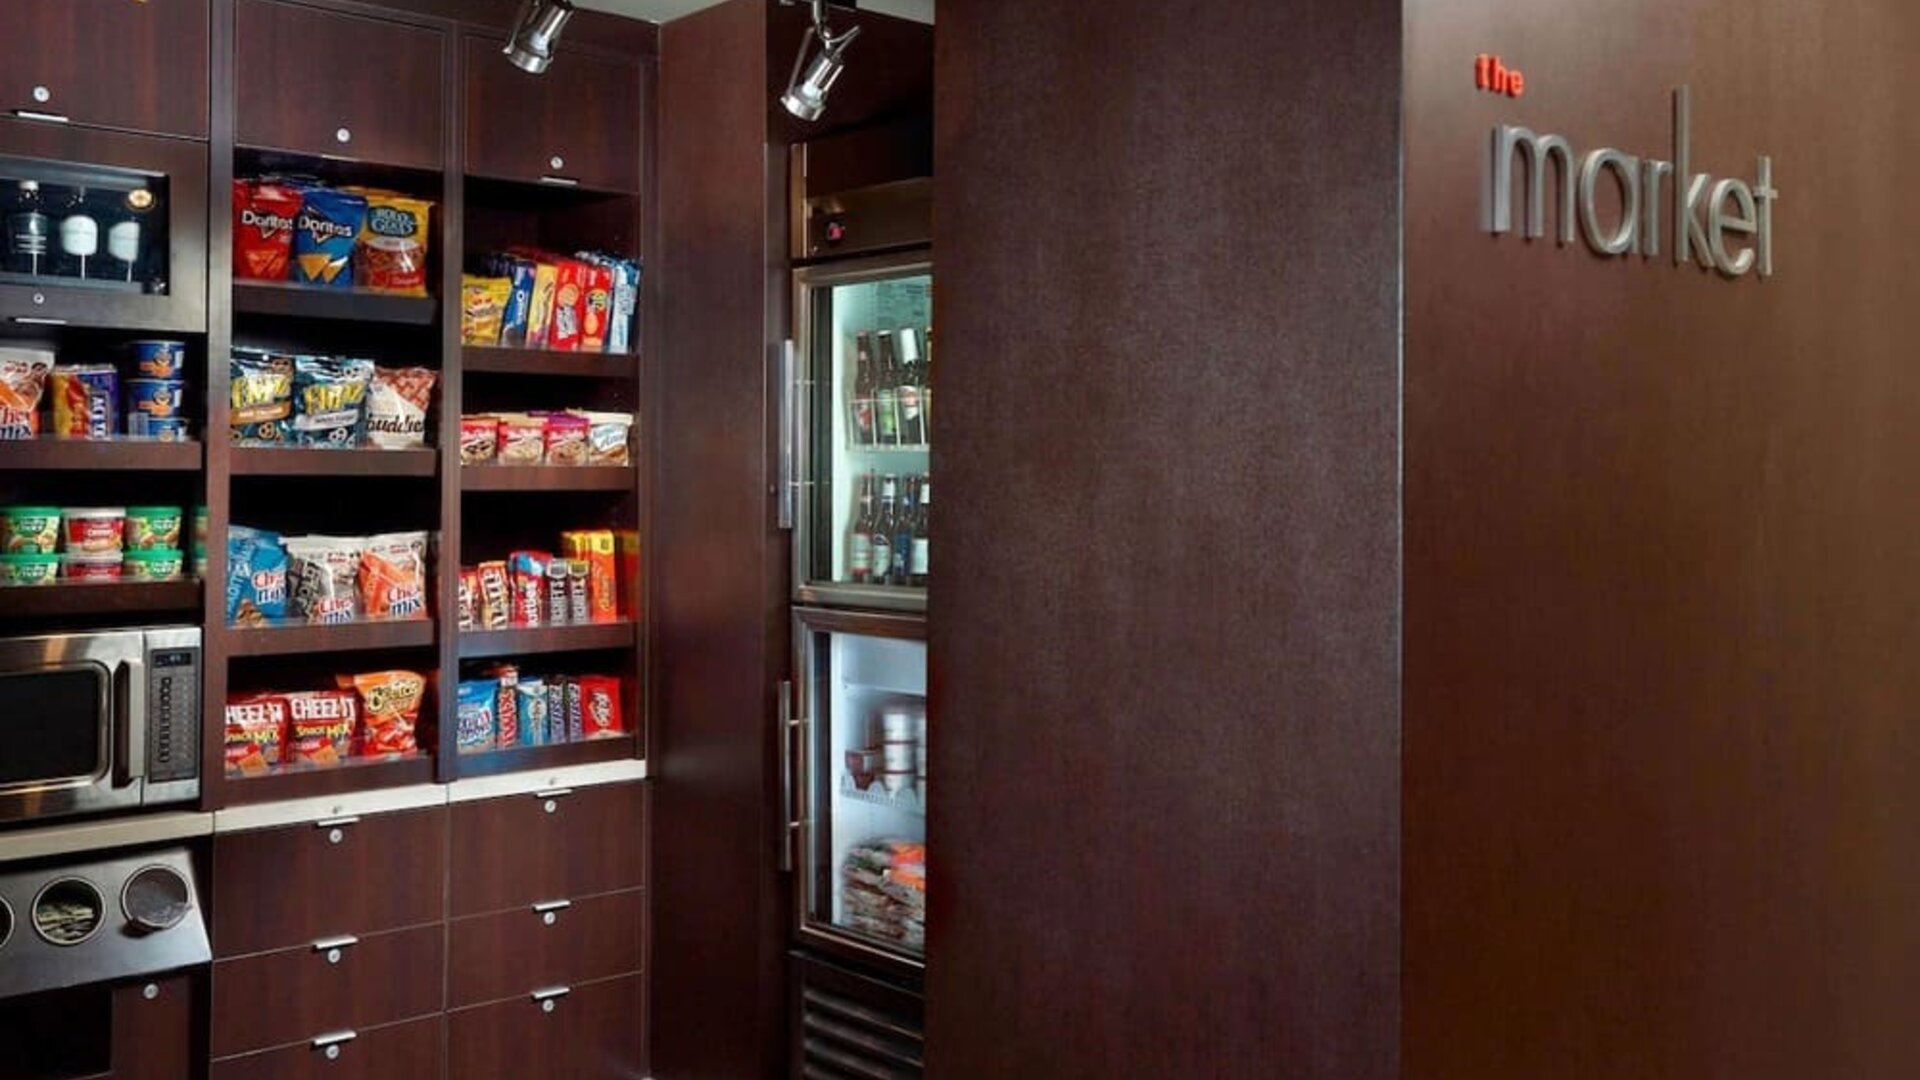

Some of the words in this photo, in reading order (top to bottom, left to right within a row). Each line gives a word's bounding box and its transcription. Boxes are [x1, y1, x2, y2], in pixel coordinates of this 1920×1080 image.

[1475, 54, 1524, 97] the
[1482, 84, 1779, 277] market
[299, 214, 353, 238] Doritos
